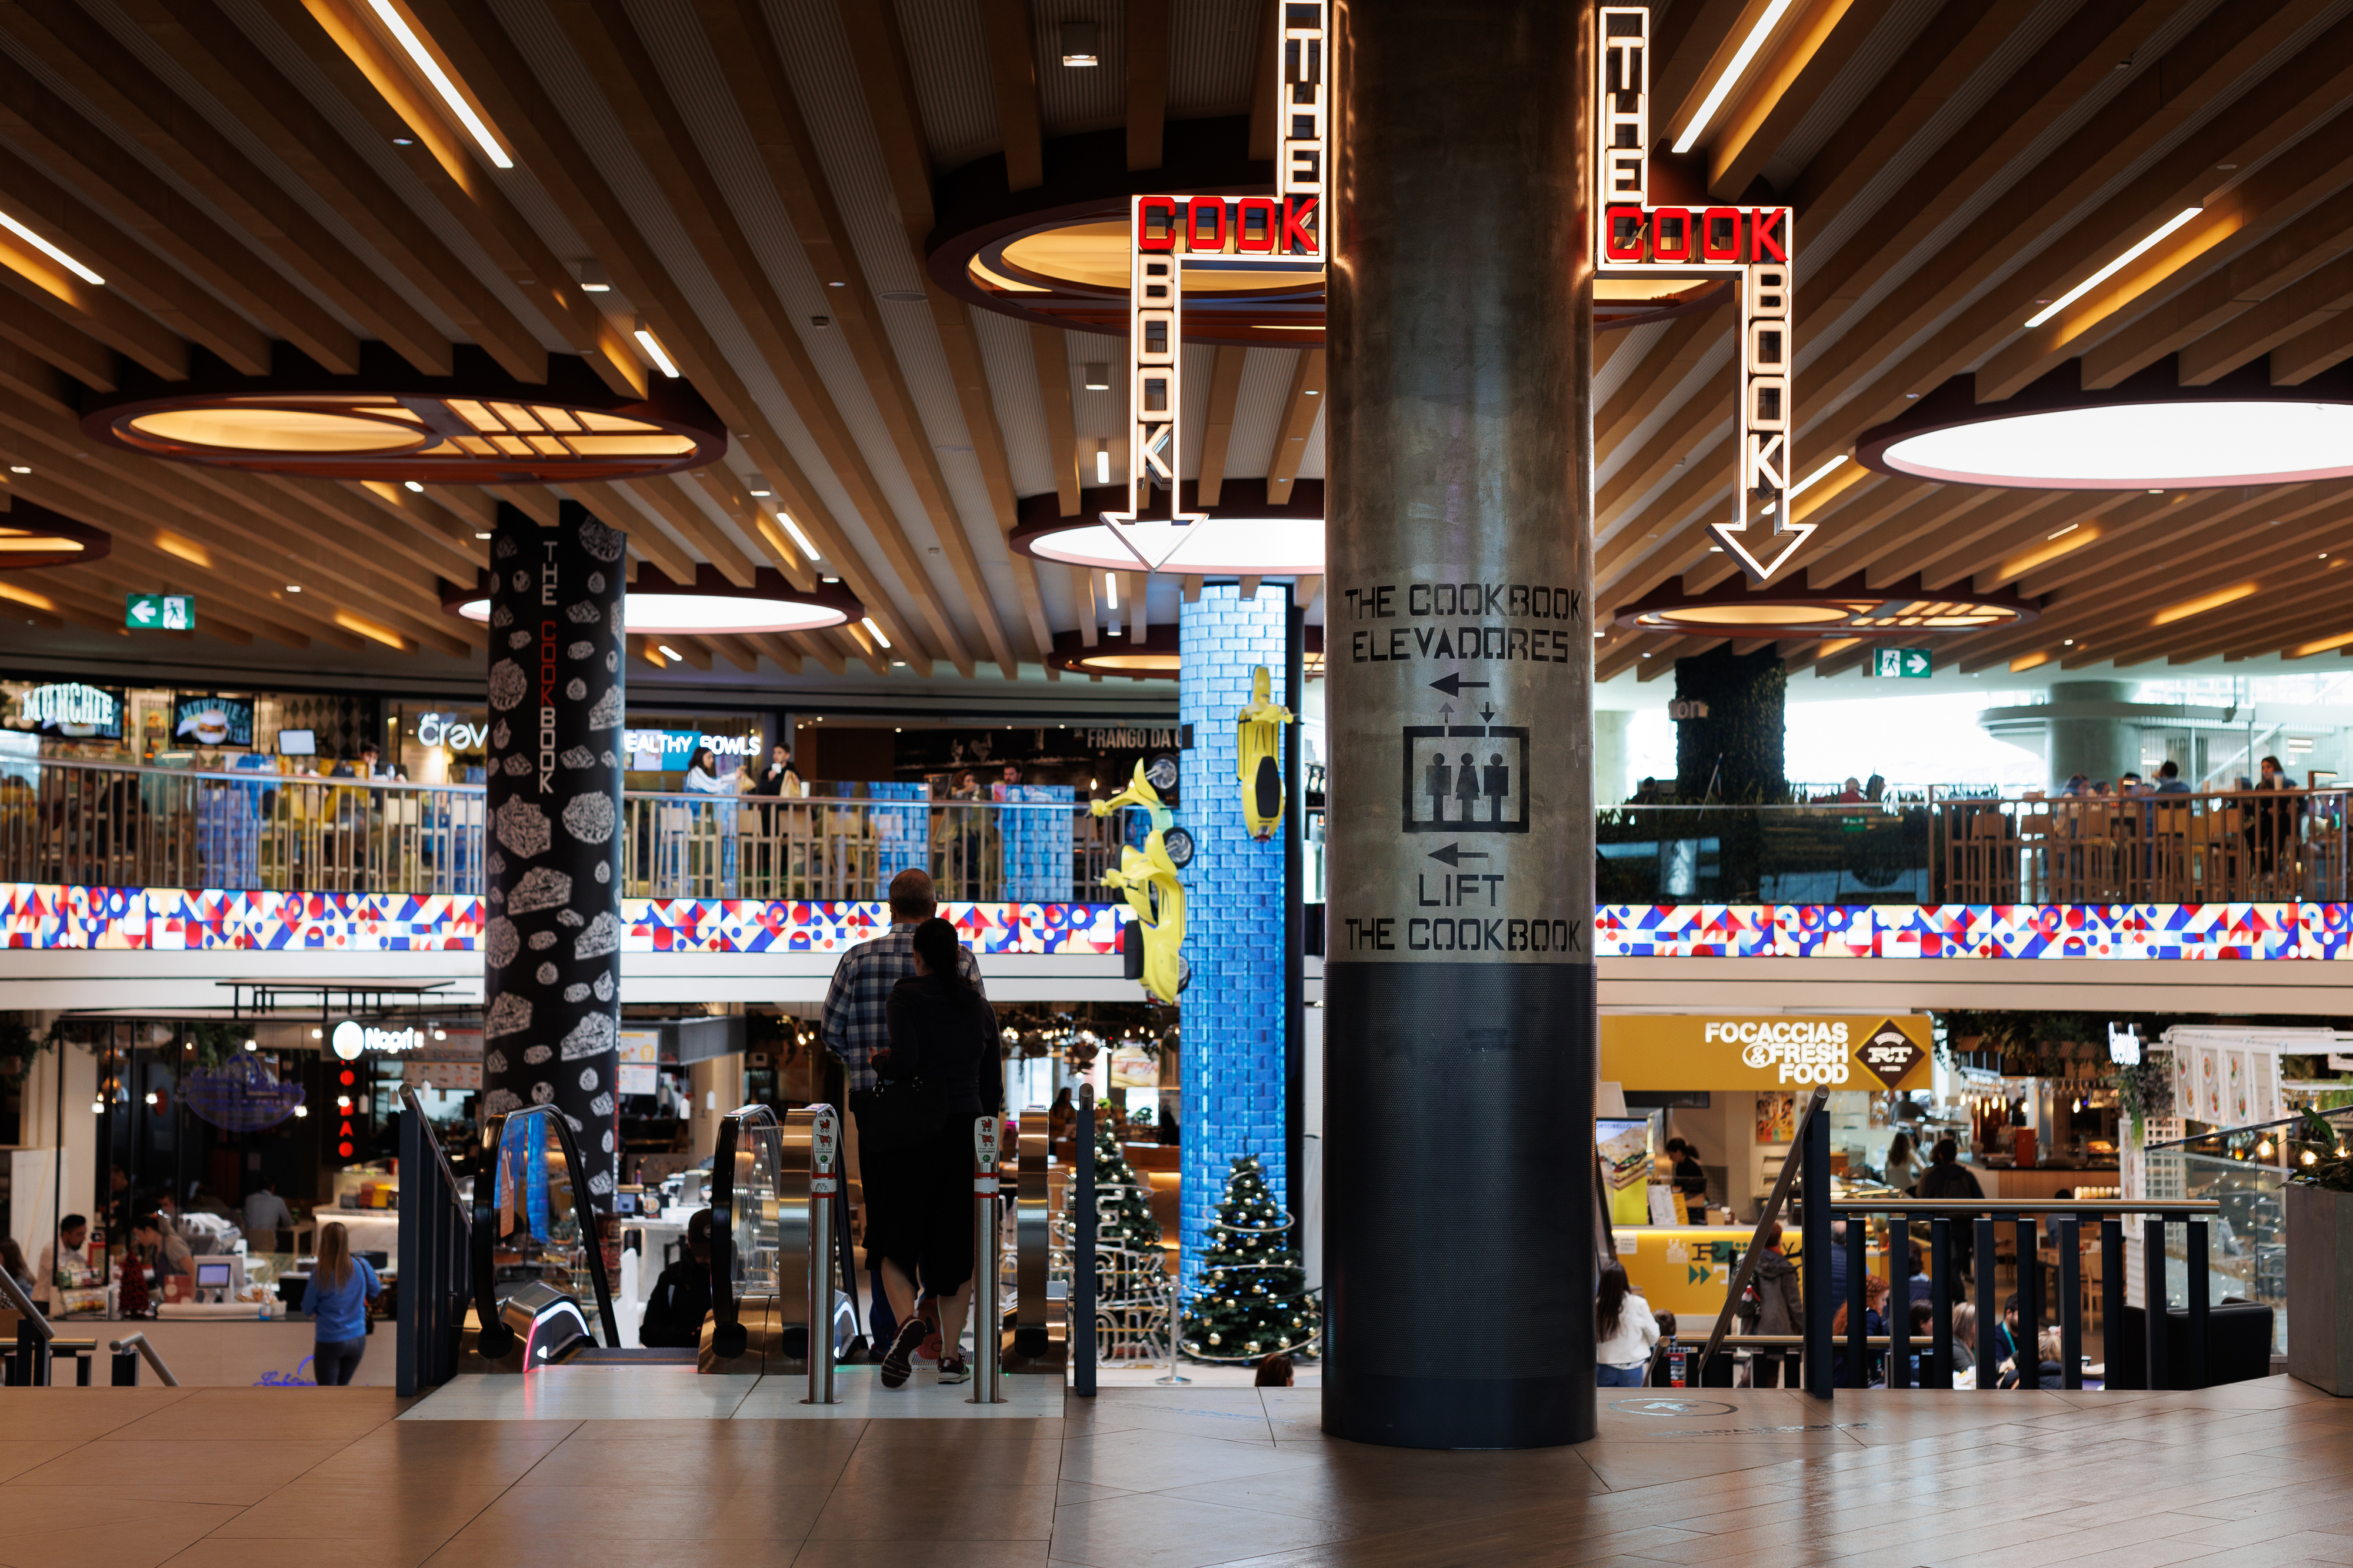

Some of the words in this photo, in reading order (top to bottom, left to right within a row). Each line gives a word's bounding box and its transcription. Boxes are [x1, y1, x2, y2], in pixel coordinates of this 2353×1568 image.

[1285, 28, 1324, 195] THE
[1606, 36, 1646, 205] THE
[1138, 196, 1319, 253] COOK
[1605, 207, 1788, 263] COOK
[1137, 253, 1176, 480] BOOK
[1749, 265, 1789, 492] BOOK
[541, 541, 558, 606] THE
[1345, 585, 1397, 620] THE
[1409, 583, 1583, 623] COOKBOOK
[1352, 626, 1569, 663] ELEVADORES
[22, 682, 114, 725] MUNCHIE
[624, 733, 693, 753] EALTHY
[1088, 728, 1146, 748] FRANGO
[1150, 729, 1172, 748] DA
[1418, 873, 1505, 907] LIFT
[1344, 918, 1396, 950] THE
[1408, 918, 1582, 952] COOKBOOK
[1705, 1022, 1849, 1043] FOCACCIAS
[1769, 1042, 1849, 1064] FRESH
[1867, 1046, 1912, 1063] RT
[1778, 1063, 1849, 1085] FOOD
